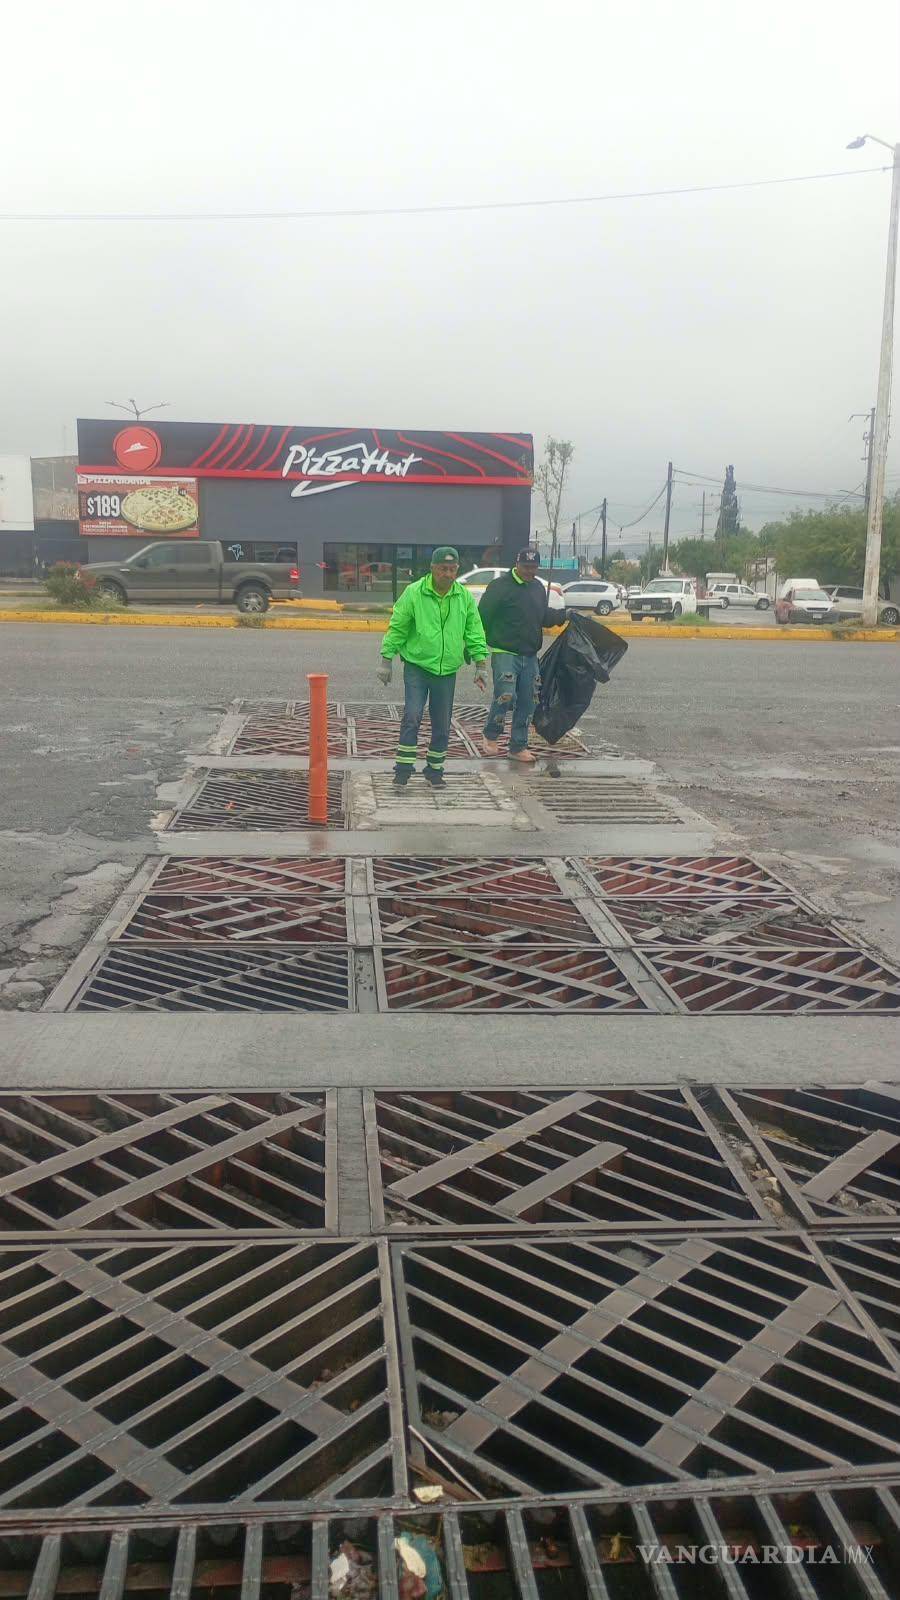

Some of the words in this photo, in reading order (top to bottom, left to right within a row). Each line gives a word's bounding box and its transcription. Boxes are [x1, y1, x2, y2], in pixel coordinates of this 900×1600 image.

[281, 444, 361, 478] Pizza
[361, 448, 423, 478] Hut
[87, 494, 120, 518] $189
